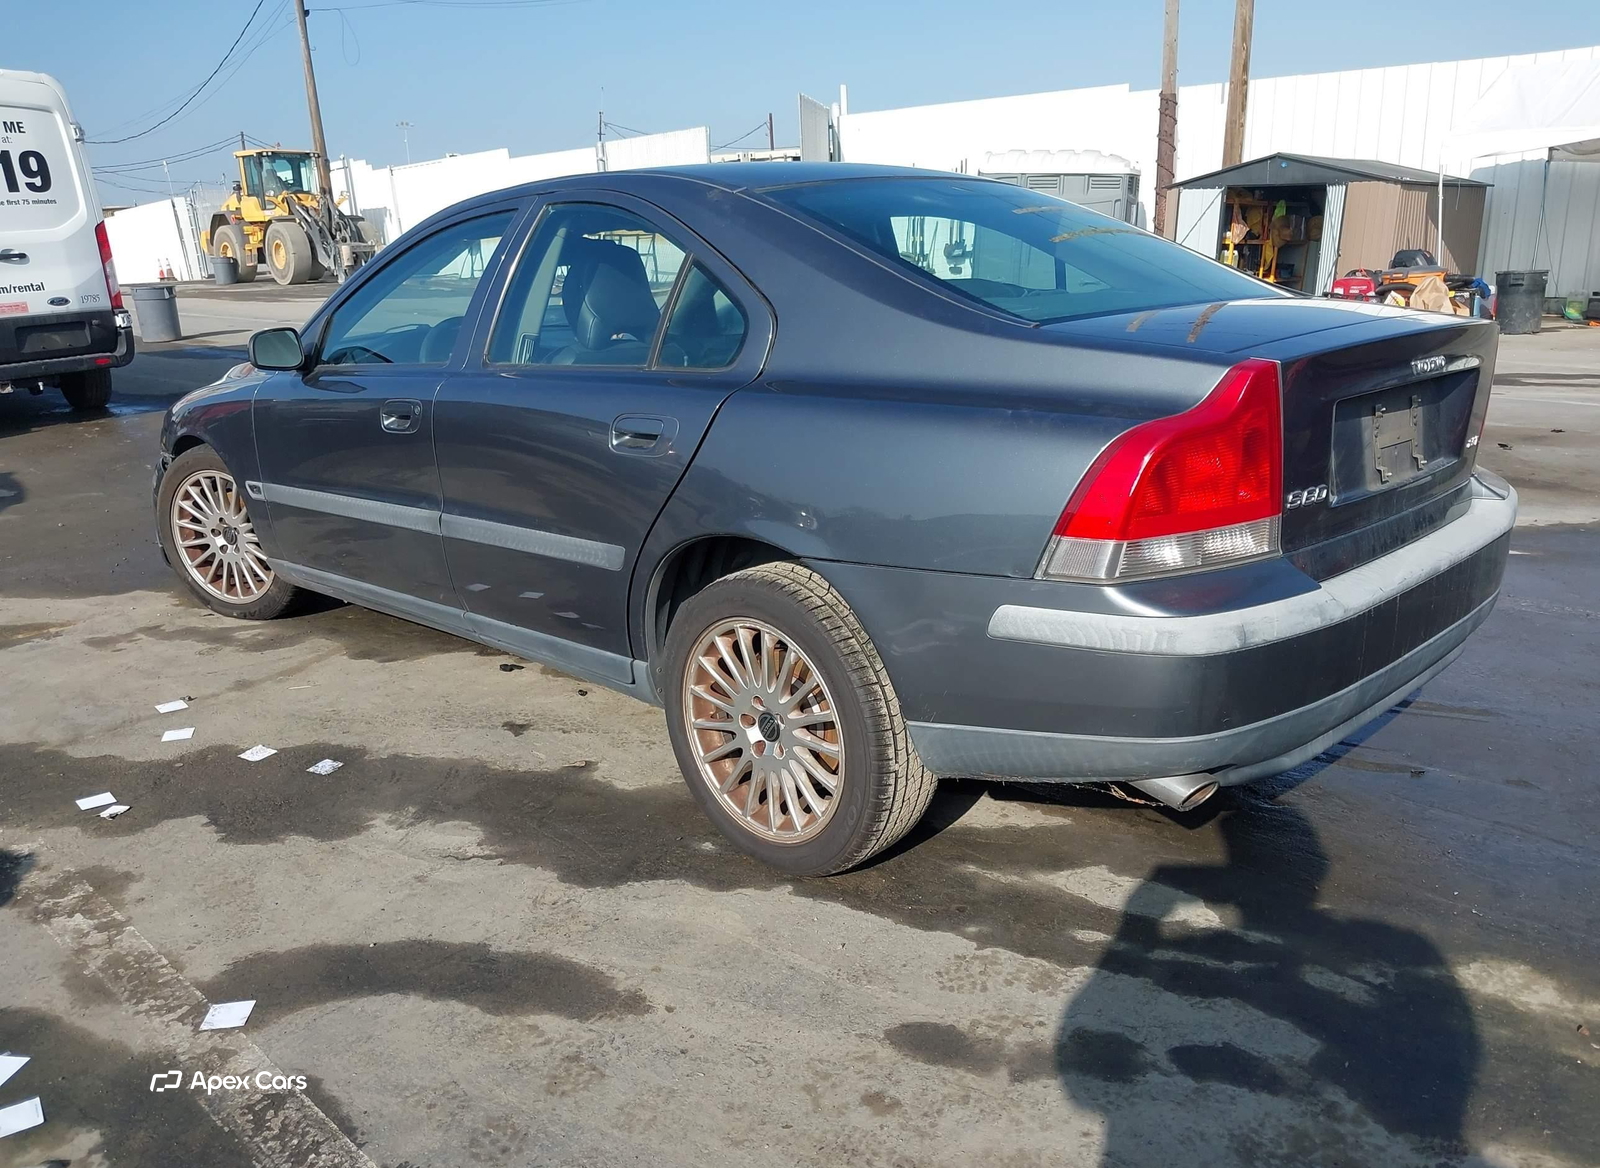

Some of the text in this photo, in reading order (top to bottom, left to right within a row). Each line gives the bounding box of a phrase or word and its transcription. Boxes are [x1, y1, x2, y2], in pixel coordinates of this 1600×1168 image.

[3, 121, 26, 134] ME
[0, 150, 52, 193] 19
[80, 294, 101, 303] 19785
